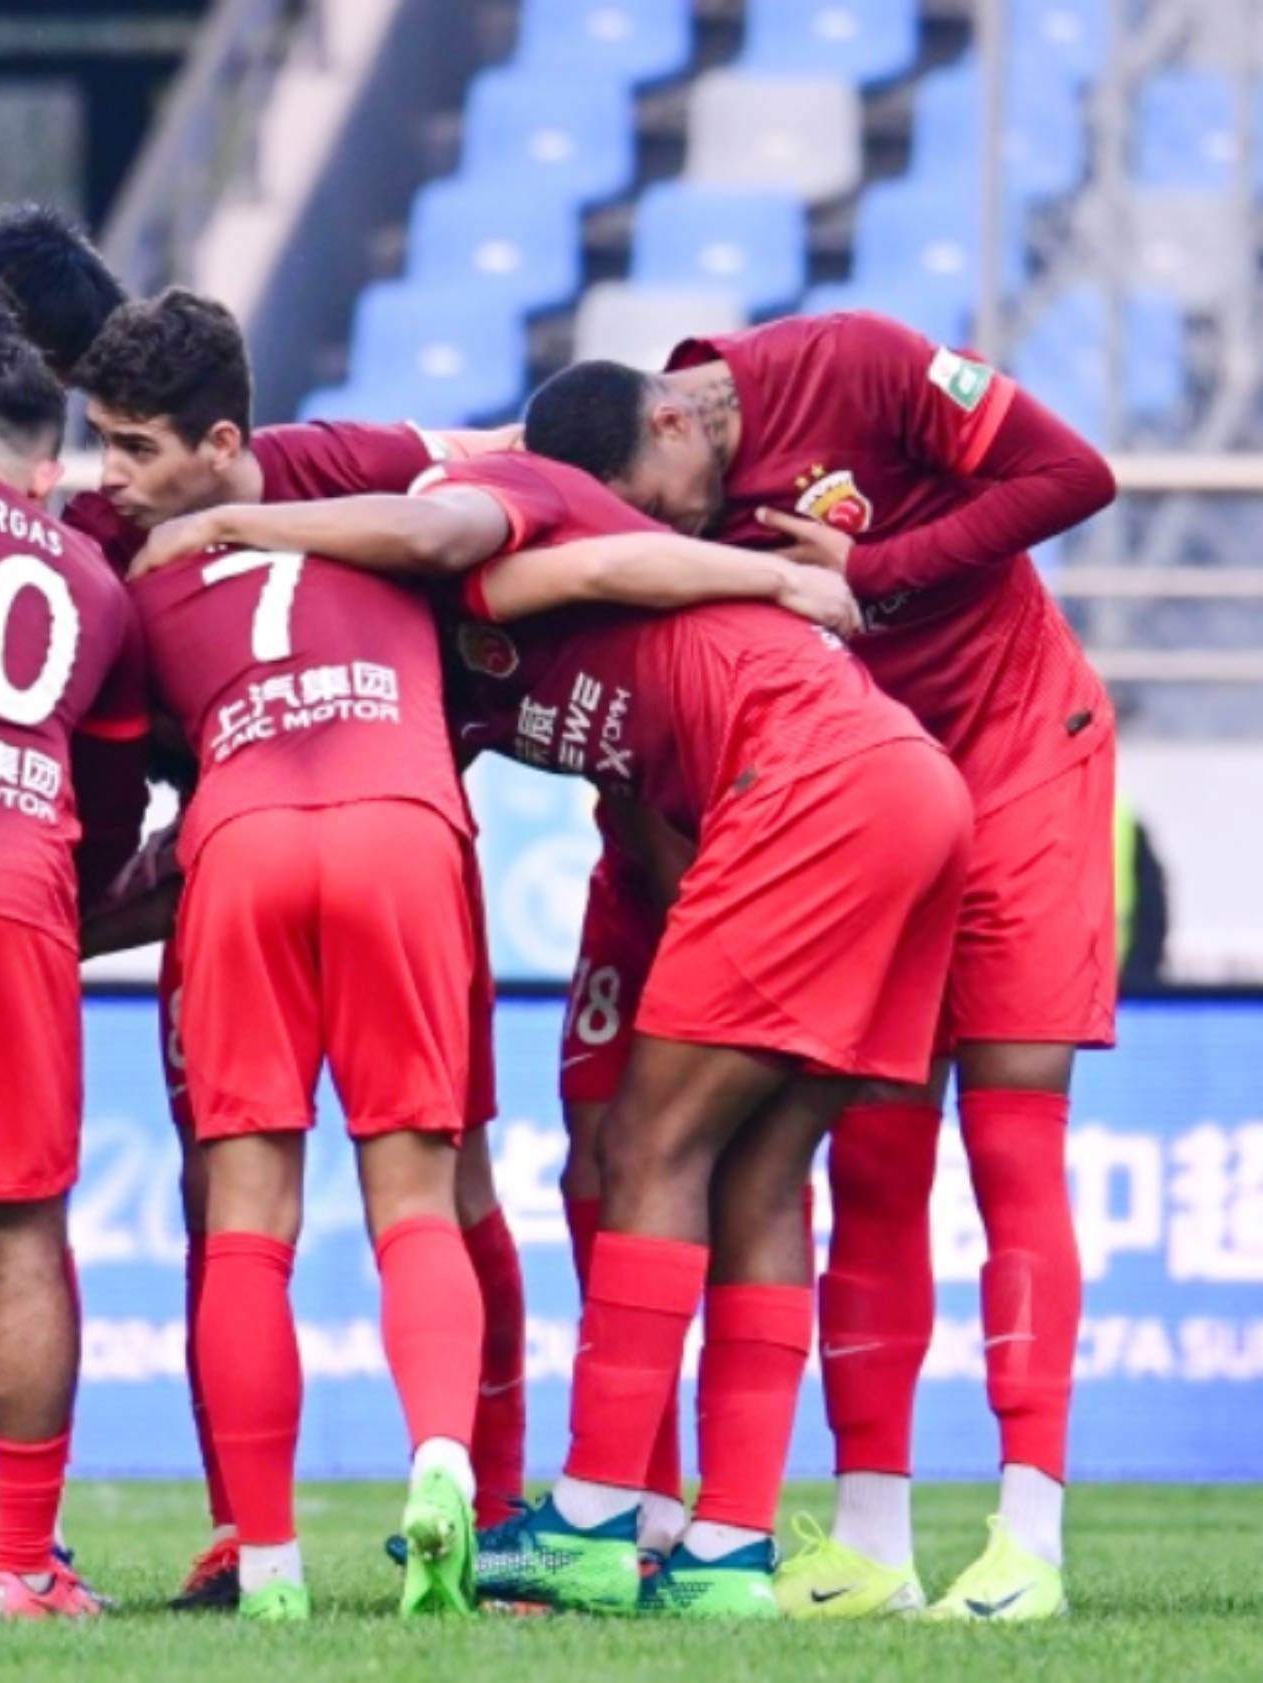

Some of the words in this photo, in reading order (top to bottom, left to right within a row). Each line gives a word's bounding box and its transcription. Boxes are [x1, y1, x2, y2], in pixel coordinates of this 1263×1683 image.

[201, 550, 306, 662] 7
[210, 660, 399, 750] 上汽集团
[214, 717, 276, 763] SAIC
[283, 699, 400, 731] MOTOR
